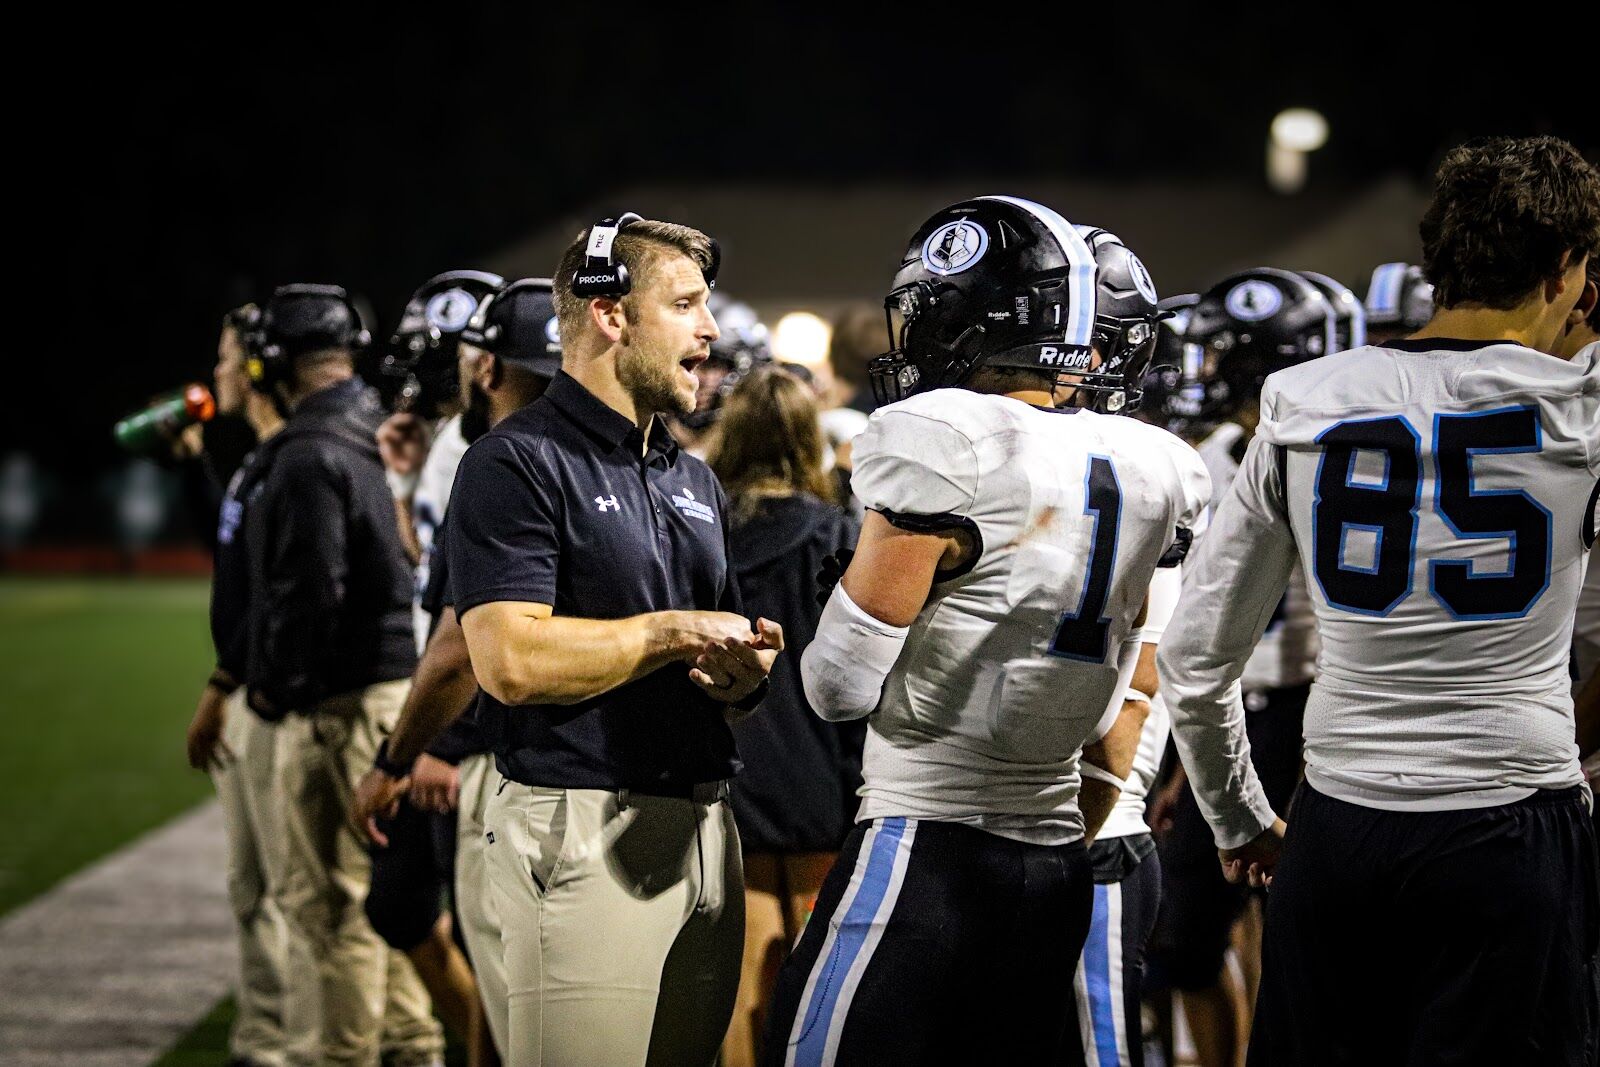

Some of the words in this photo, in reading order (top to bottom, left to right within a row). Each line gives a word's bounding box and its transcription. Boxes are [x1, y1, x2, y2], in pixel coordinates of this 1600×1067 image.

[579, 274, 615, 284] PROCOM
[1053, 304, 1061, 324] 1
[1040, 346, 1092, 369] Ridde
[1312, 404, 1553, 621] 85
[1047, 453, 1124, 664] 1
